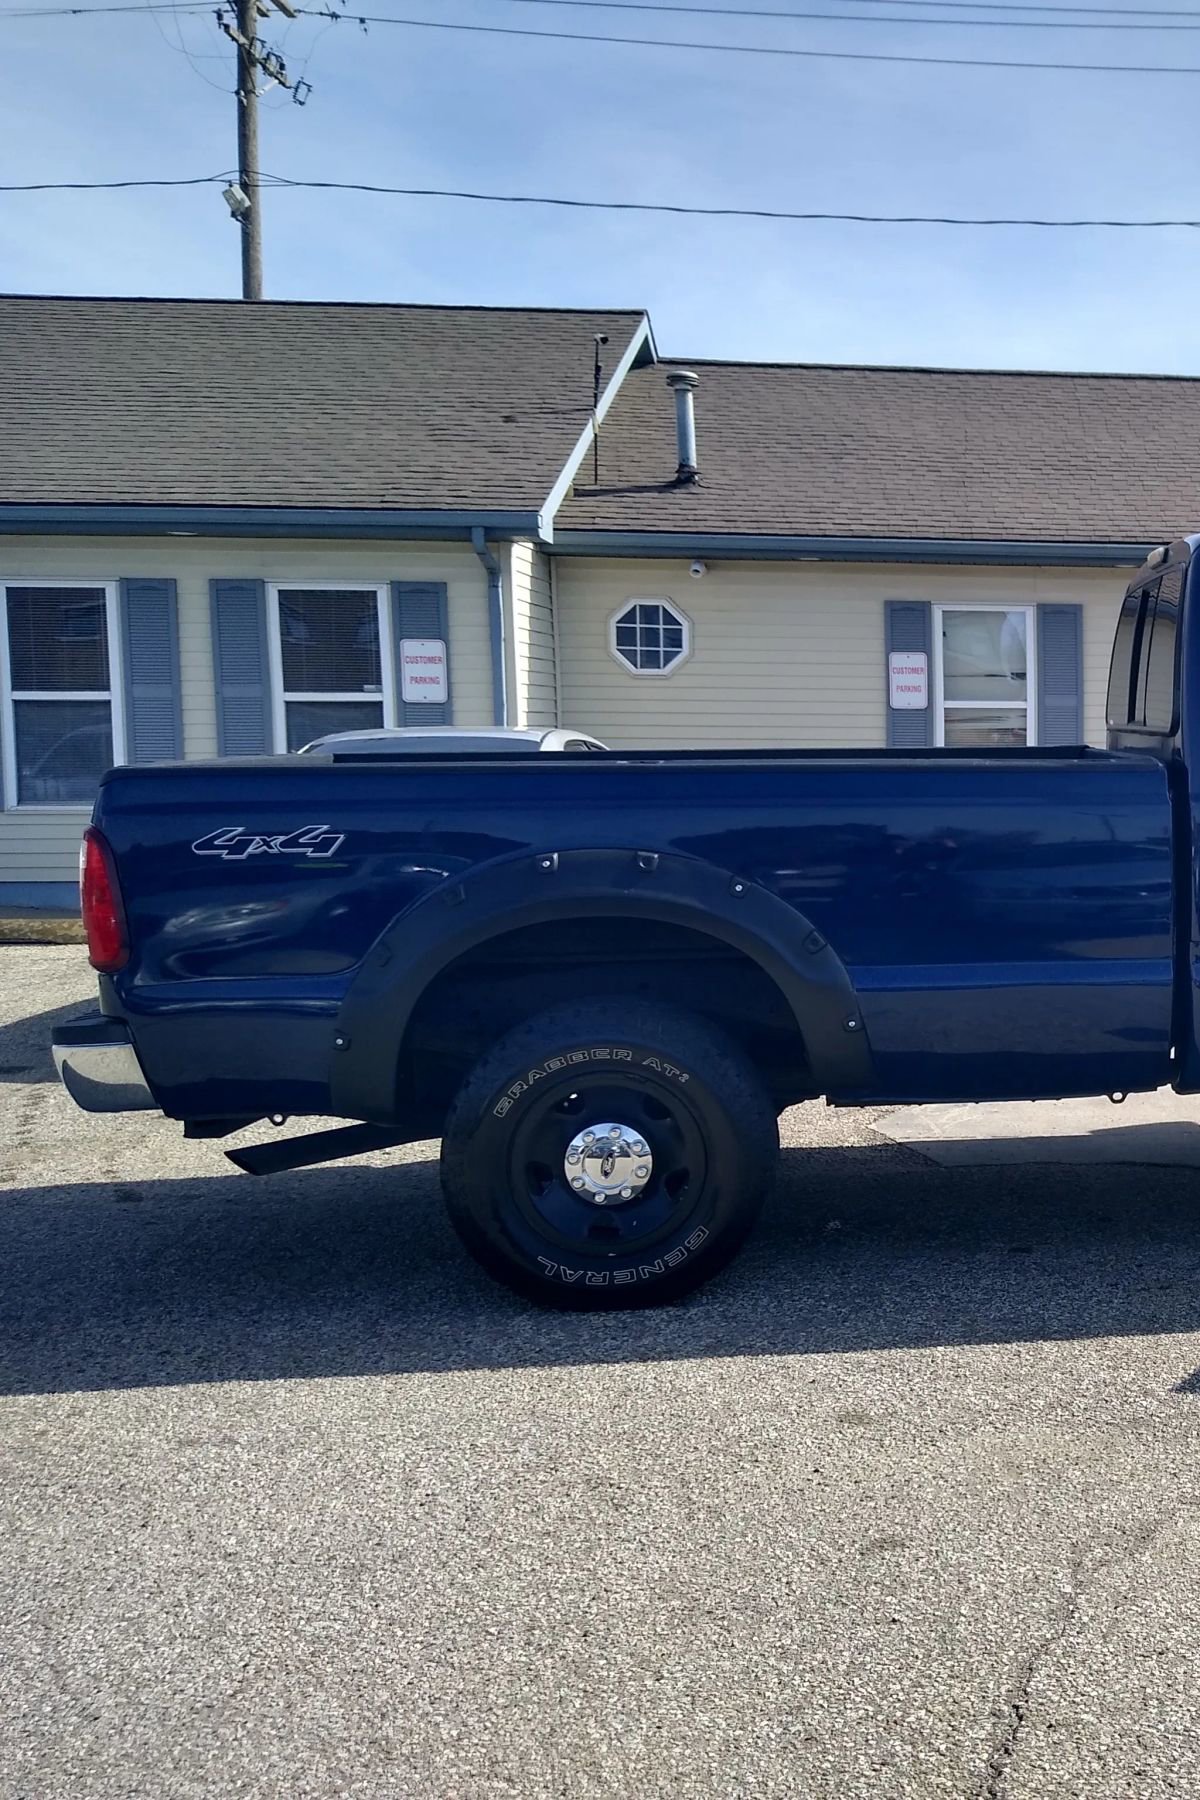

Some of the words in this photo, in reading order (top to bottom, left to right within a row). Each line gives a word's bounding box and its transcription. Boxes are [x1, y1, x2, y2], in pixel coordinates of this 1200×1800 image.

[405, 656, 443, 664] CUSTOMER
[892, 666, 925, 675] CUSTOMER
[409, 676, 441, 685] PARKING
[896, 685, 922, 693] PARKING
[493, 1048, 633, 1118] GRABBER
[537, 1225, 710, 1286] GENERAL
